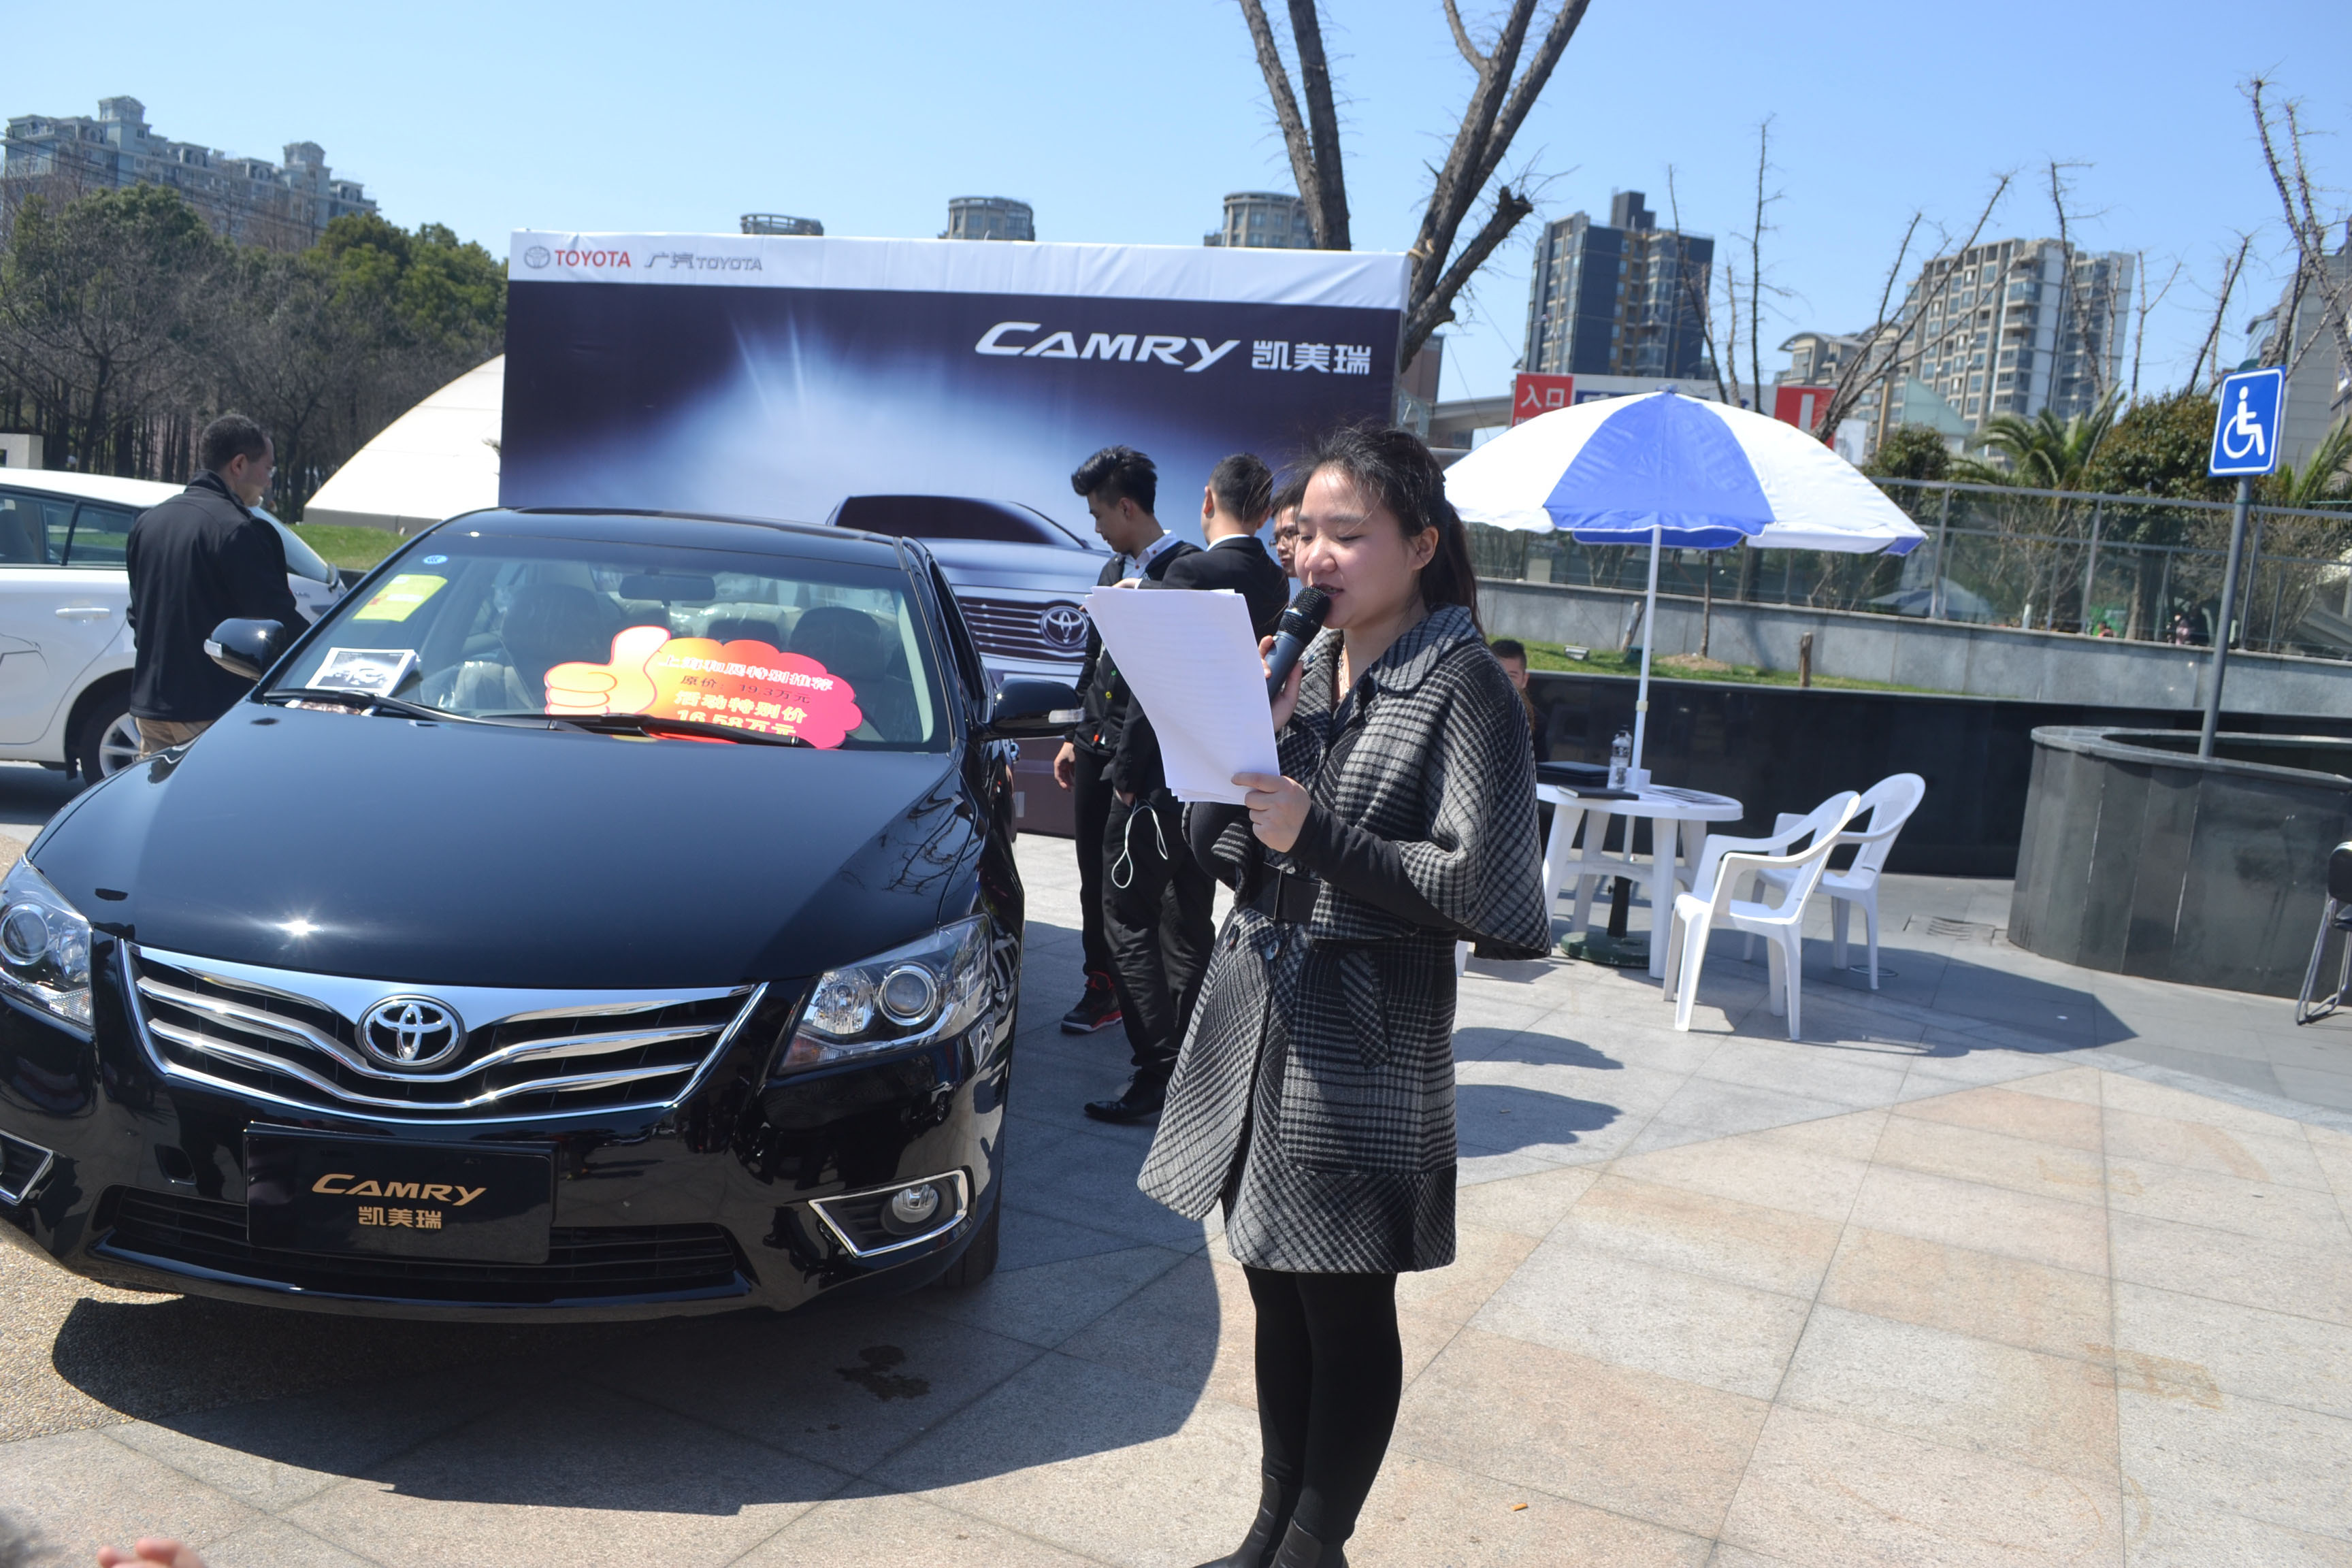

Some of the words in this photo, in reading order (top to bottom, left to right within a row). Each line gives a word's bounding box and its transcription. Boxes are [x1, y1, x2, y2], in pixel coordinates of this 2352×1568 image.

[555, 250, 631, 267] TOYOTA
[975, 321, 1241, 373] CAMRY
[1252, 340, 1372, 375] 凯美瑞
[1520, 384, 1565, 408] 入口
[674, 690, 808, 724] 活动特别价
[312, 1173, 487, 1207] CAMRY
[359, 1206, 442, 1229] 凯美瑞
